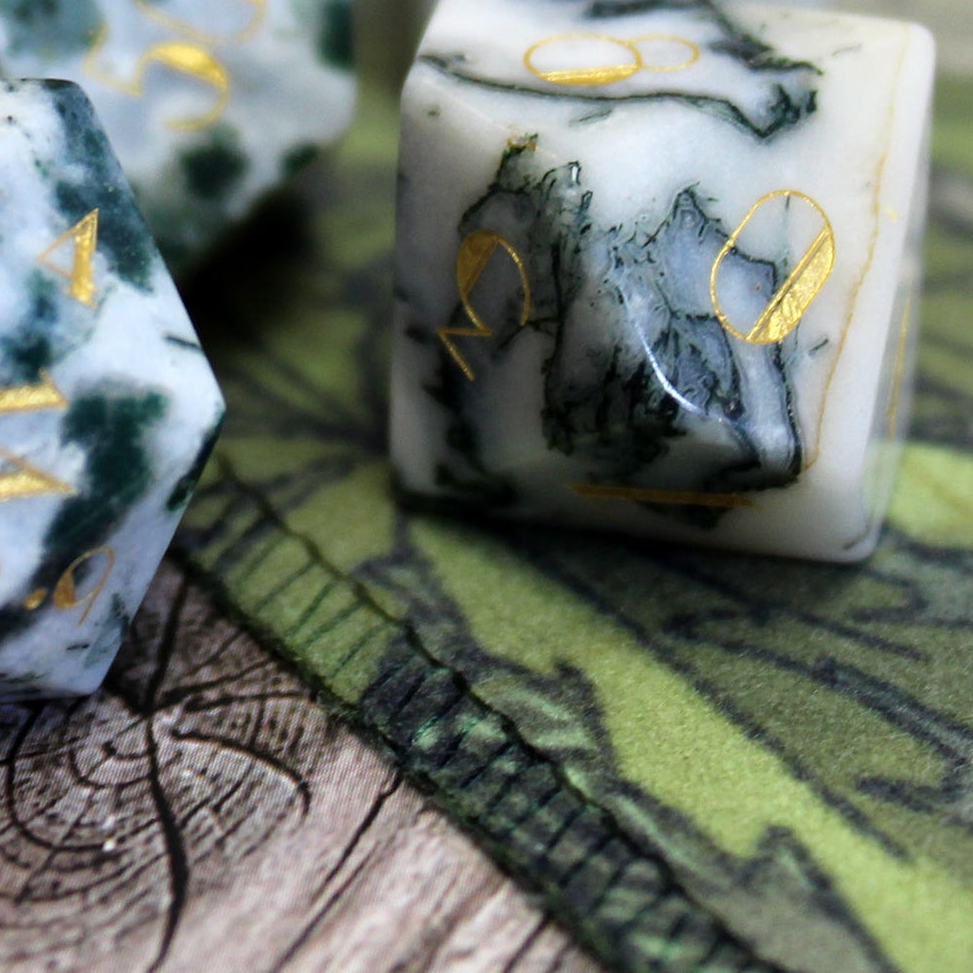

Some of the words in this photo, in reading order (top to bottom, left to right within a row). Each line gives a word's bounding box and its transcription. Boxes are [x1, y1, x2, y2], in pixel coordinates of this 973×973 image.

[523, 33, 700, 86] 8
[35, 207, 100, 310] 4
[709, 190, 836, 345] 0
